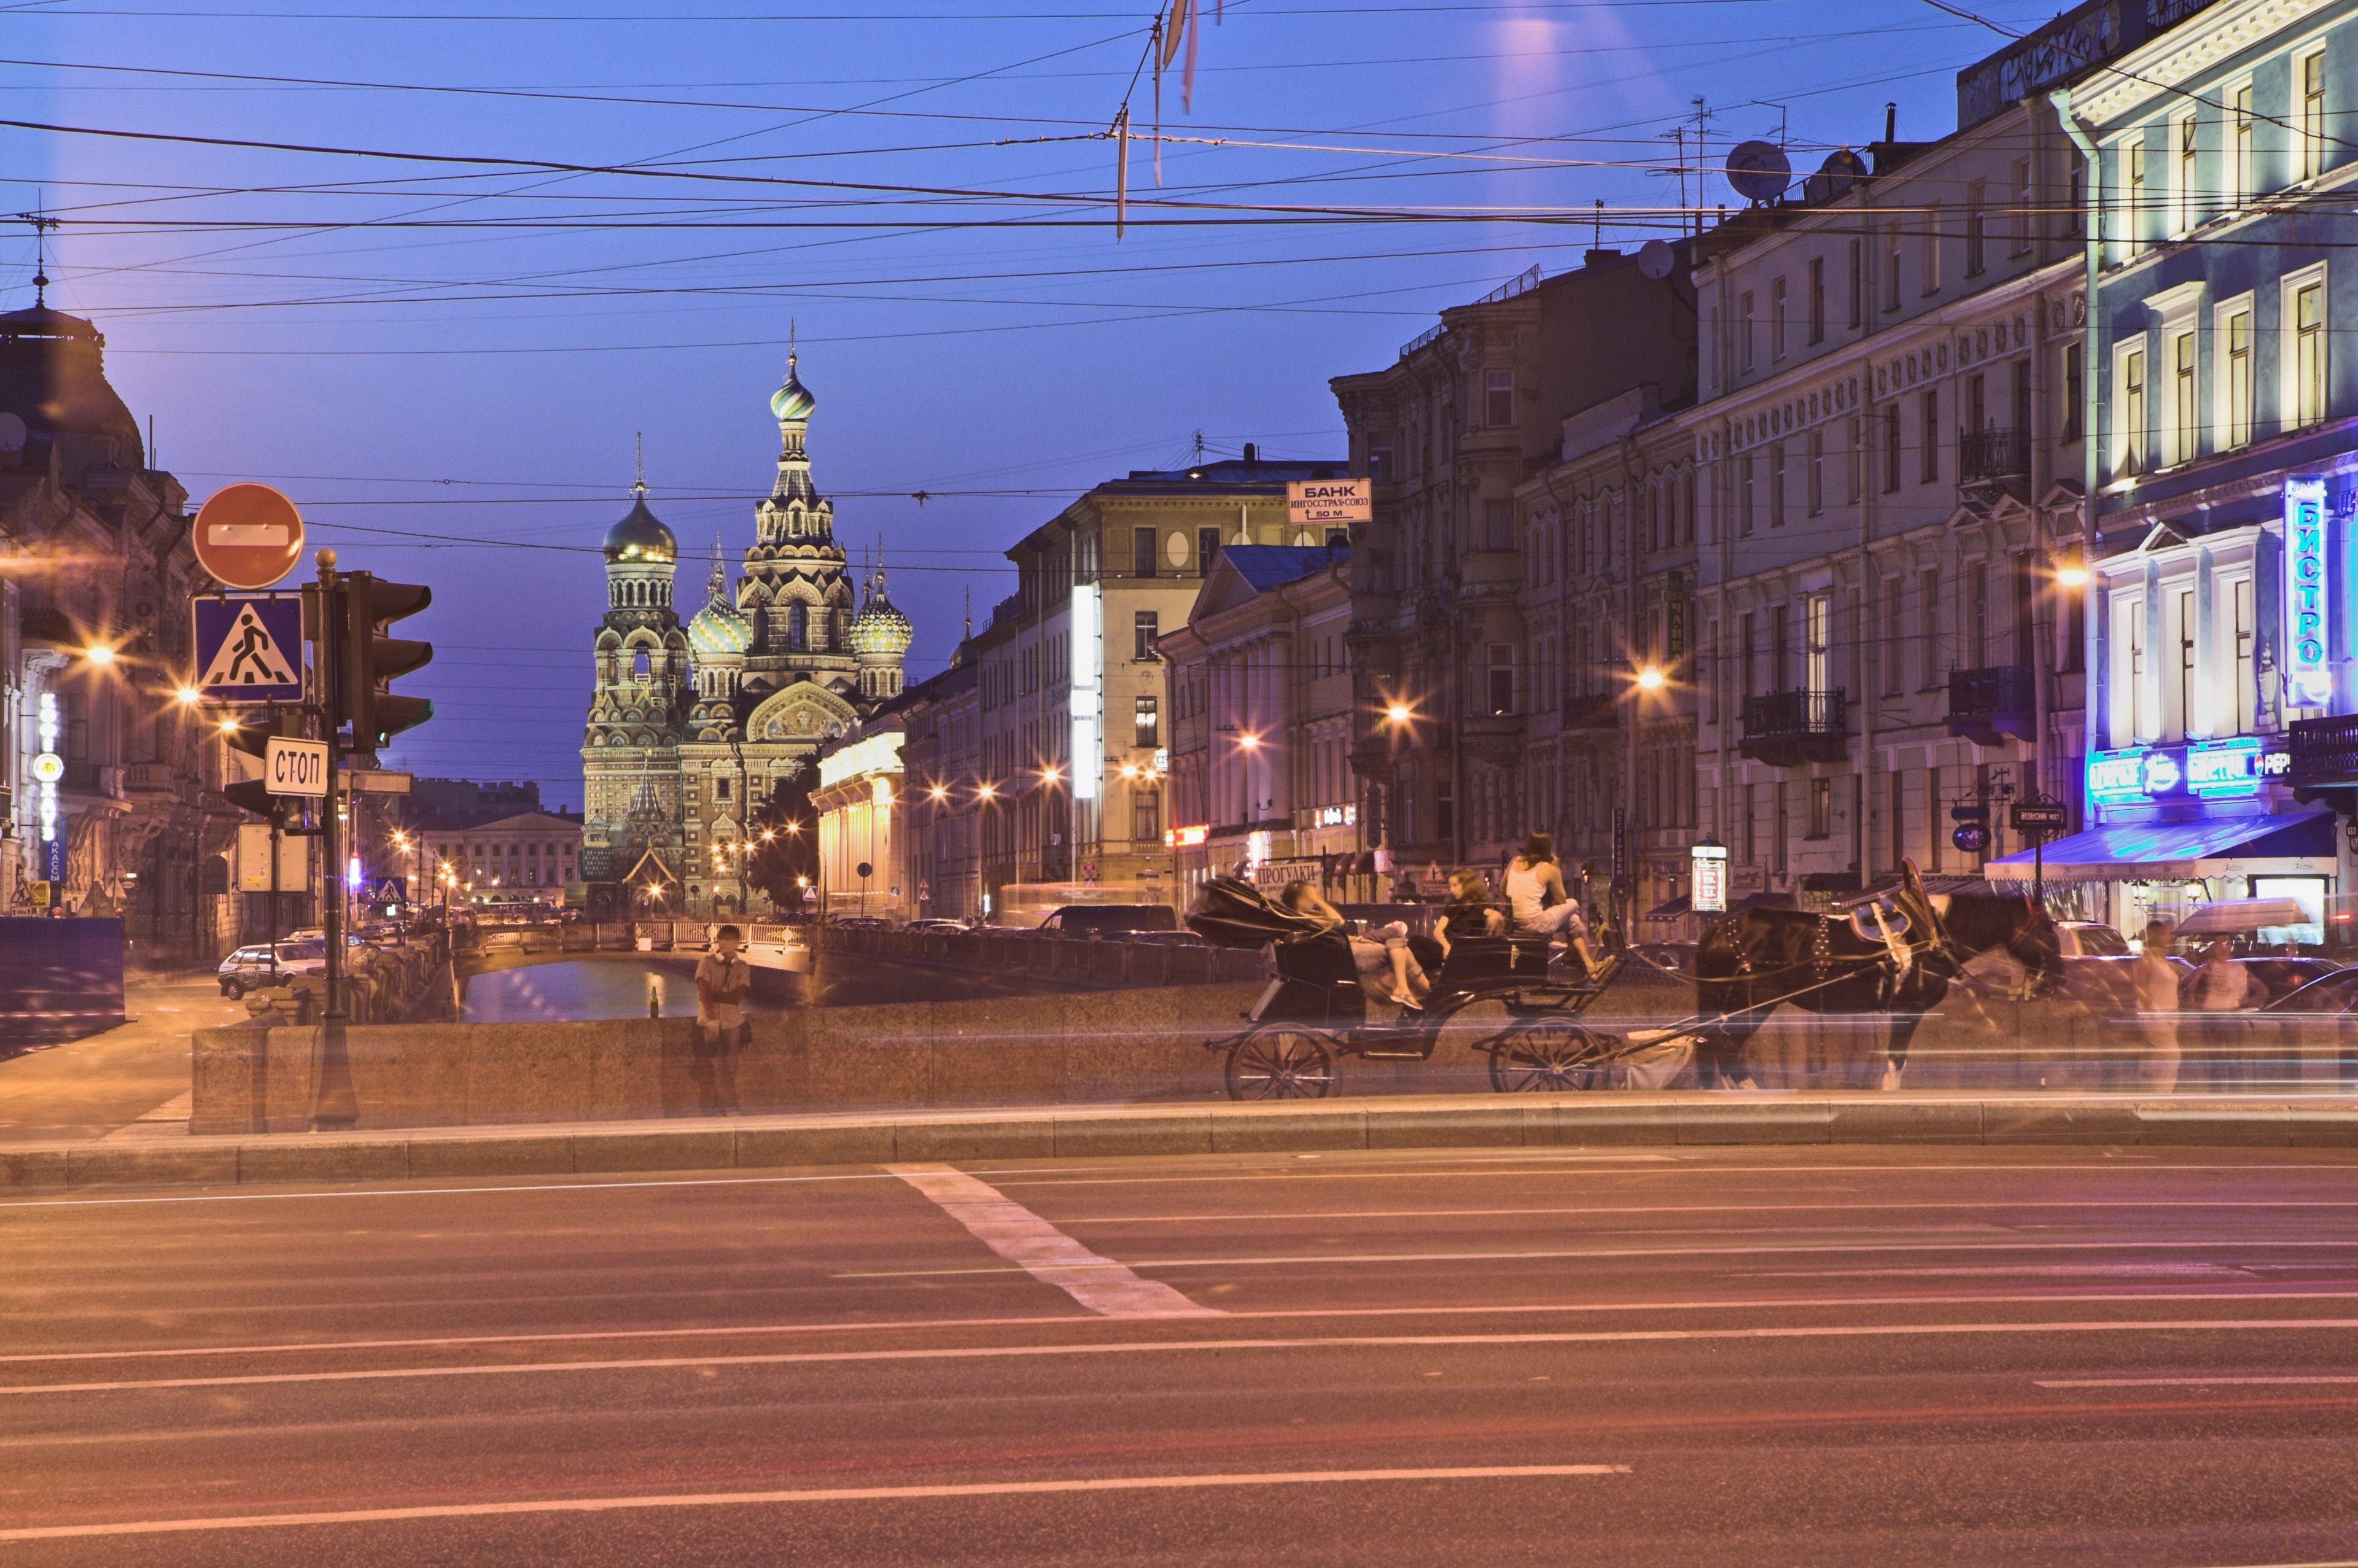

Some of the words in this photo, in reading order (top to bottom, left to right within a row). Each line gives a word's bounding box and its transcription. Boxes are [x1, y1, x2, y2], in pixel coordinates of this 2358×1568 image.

[1305, 486, 1355, 497] БАНК
[2297, 502, 2323, 664] БИСТРО
[1671, 603, 1683, 664] ЧАЙКА
[276, 750, 319, 784] СТОП
[2265, 754, 2290, 774] PEP
[1370, 791, 1379, 843] ОПТИКА
[1258, 865, 1315, 884] ПРОГУЛКИ
